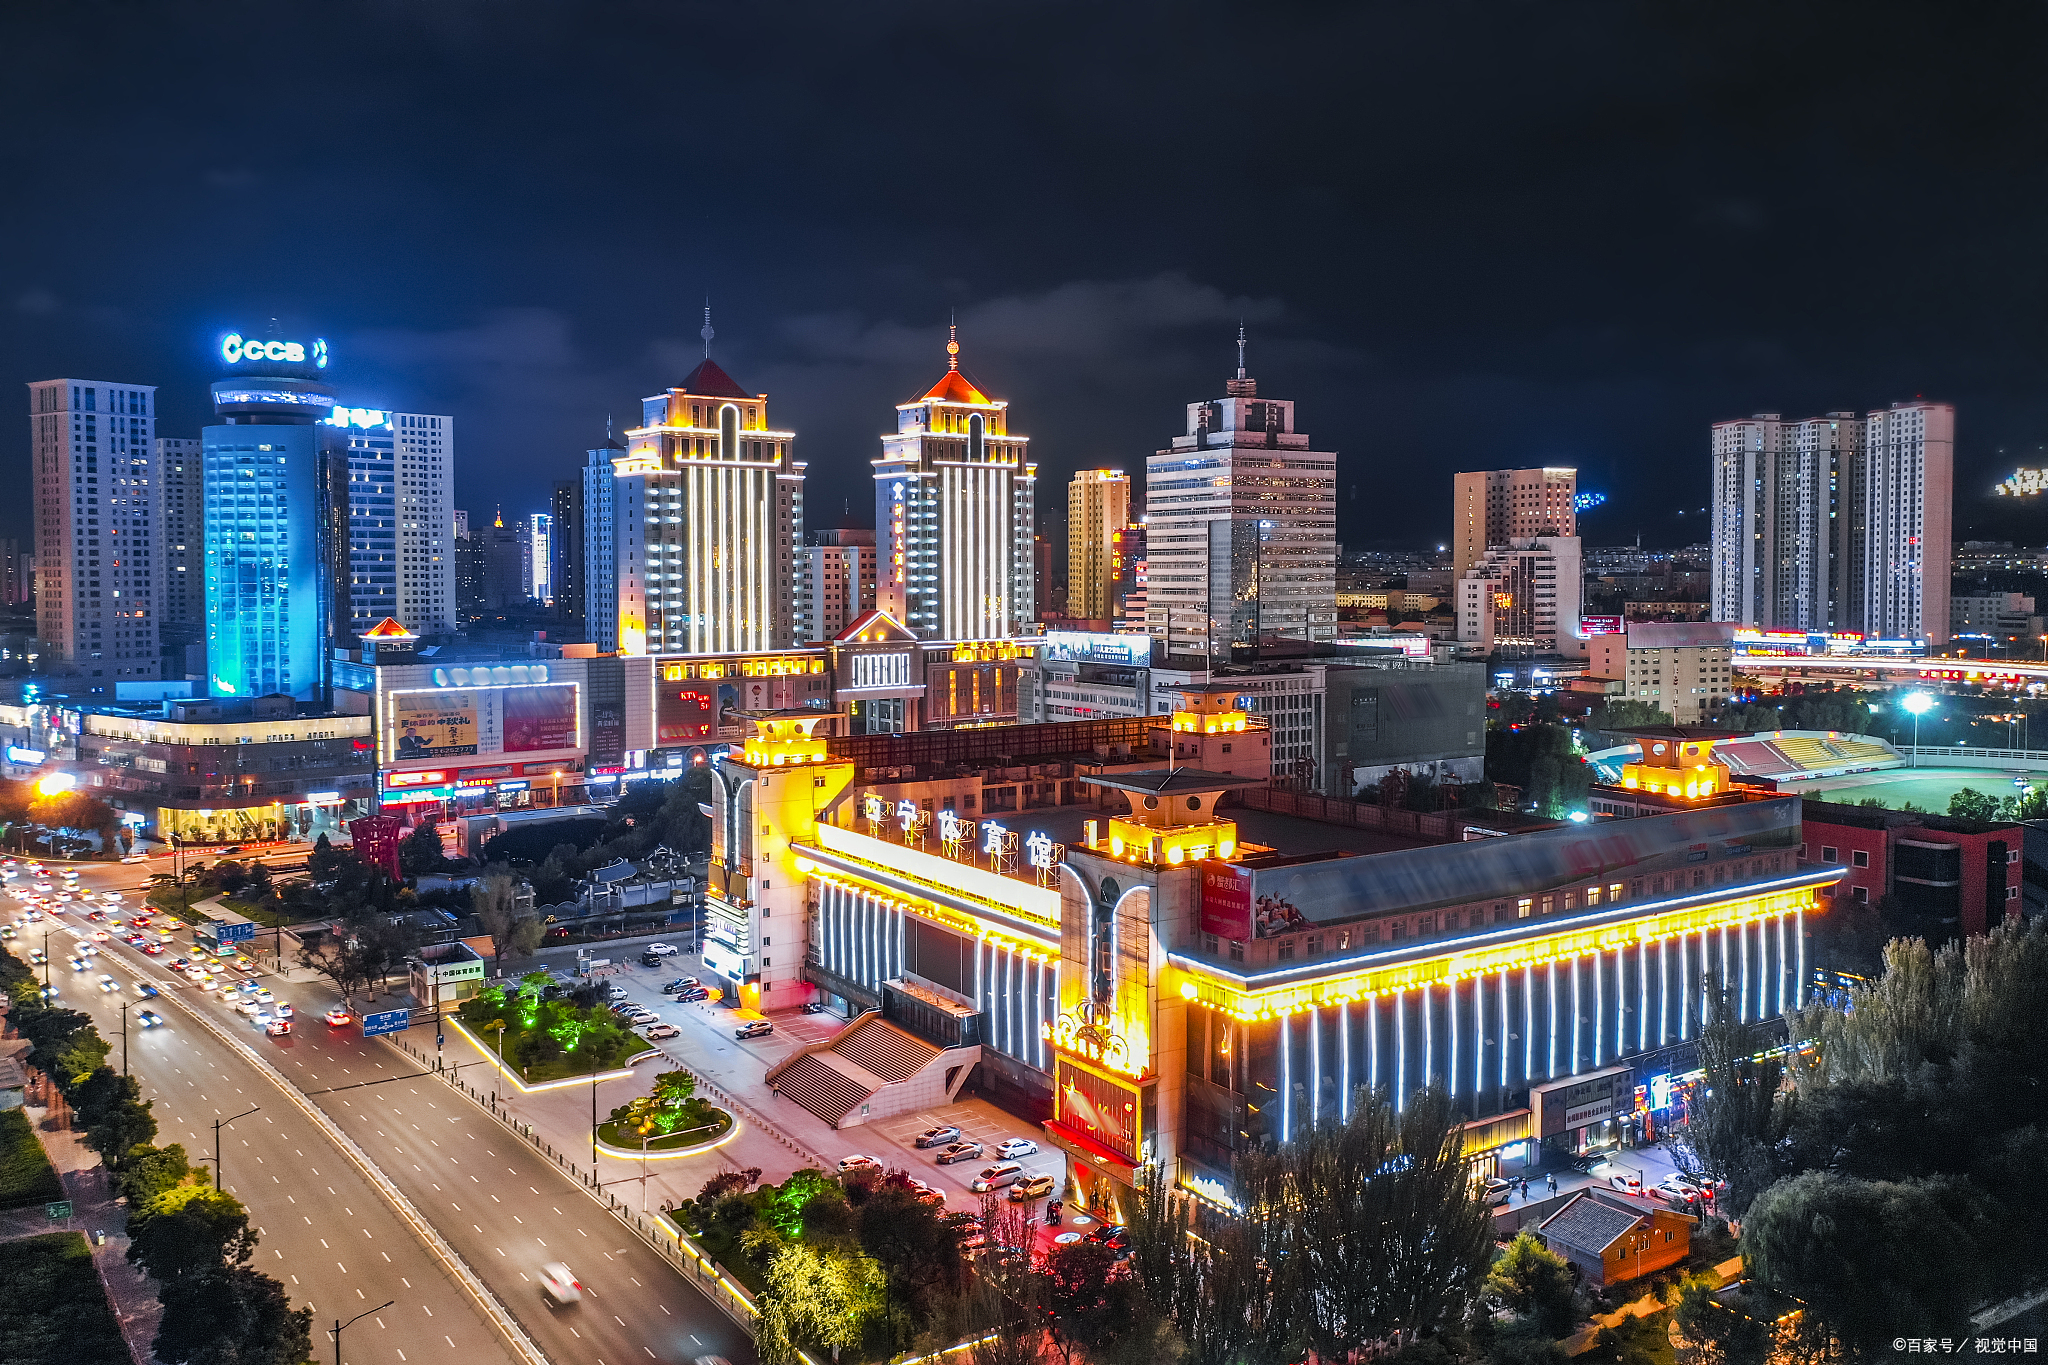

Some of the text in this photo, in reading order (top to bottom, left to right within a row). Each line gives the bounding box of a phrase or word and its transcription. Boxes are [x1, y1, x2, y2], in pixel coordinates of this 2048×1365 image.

[242, 340, 306, 362] CCB
[863, 792, 1052, 869] 西宁体育馆
[442, 966, 481, 978] 中国体育彩票
